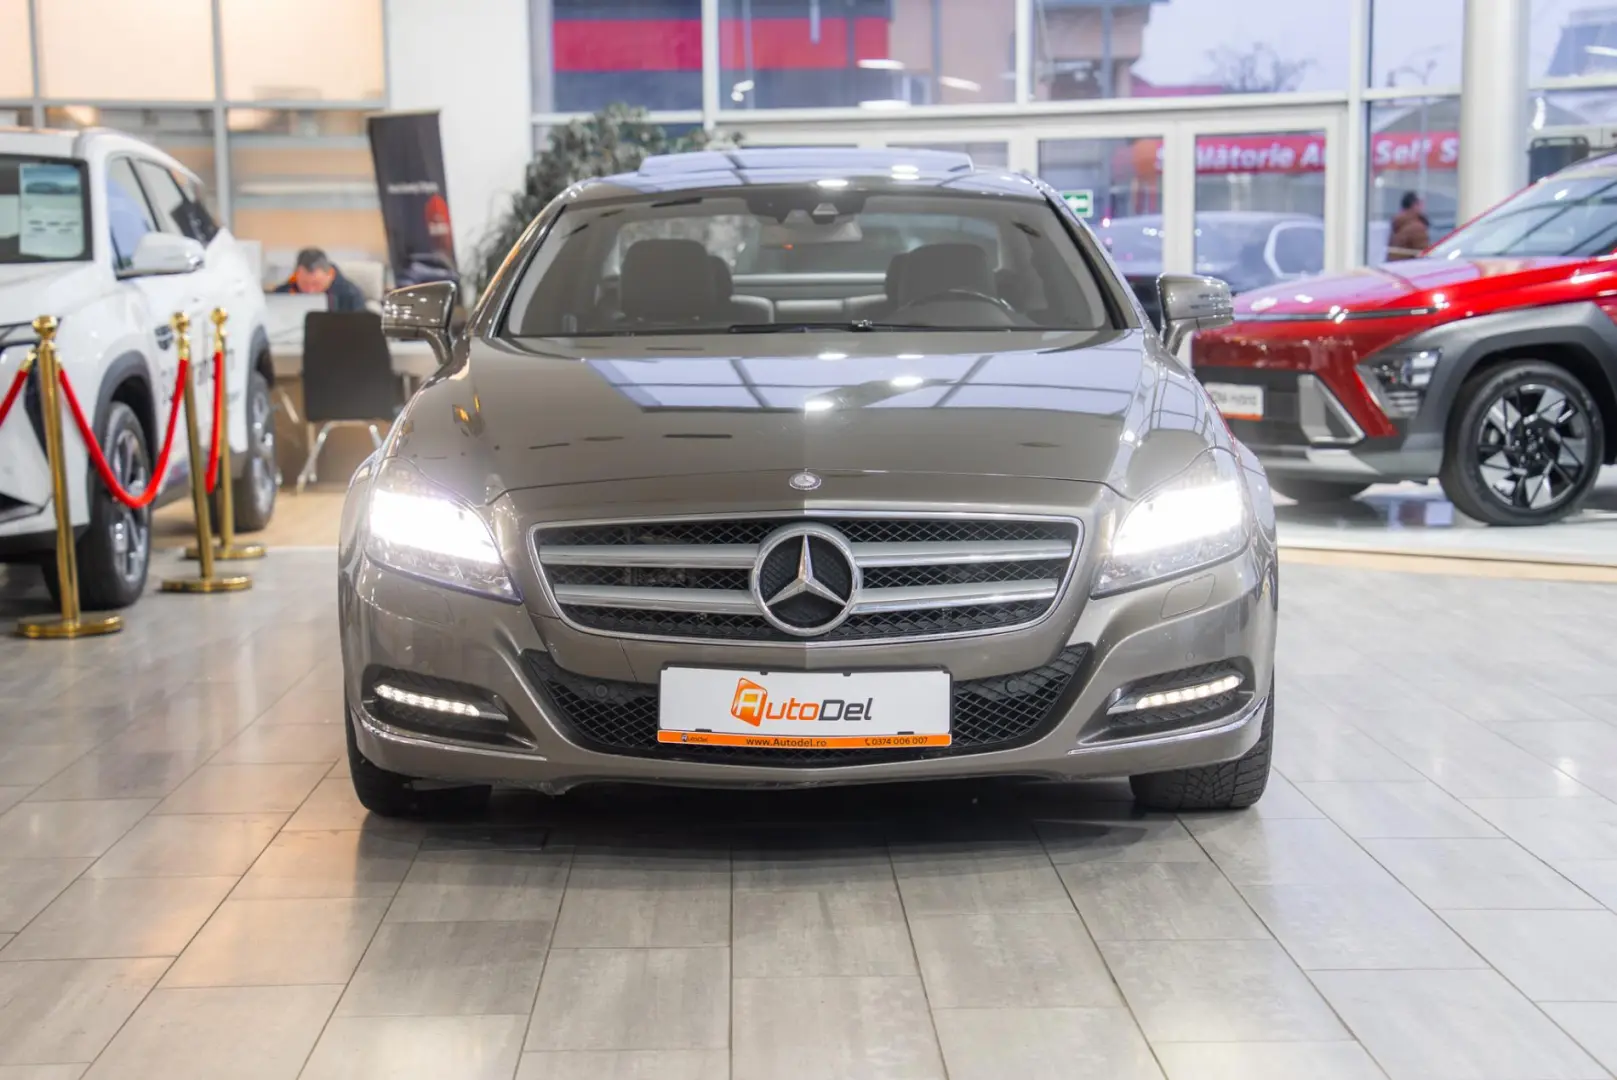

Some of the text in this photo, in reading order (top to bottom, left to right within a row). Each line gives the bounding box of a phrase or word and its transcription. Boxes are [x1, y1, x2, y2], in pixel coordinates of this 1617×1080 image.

[732, 680, 873, 724] AutoDel
[746, 737, 827, 748] www.Autodel.ro
[872, 738, 891, 746] 0374
[893, 737, 910, 745] 006
[912, 736, 928, 744] 007
